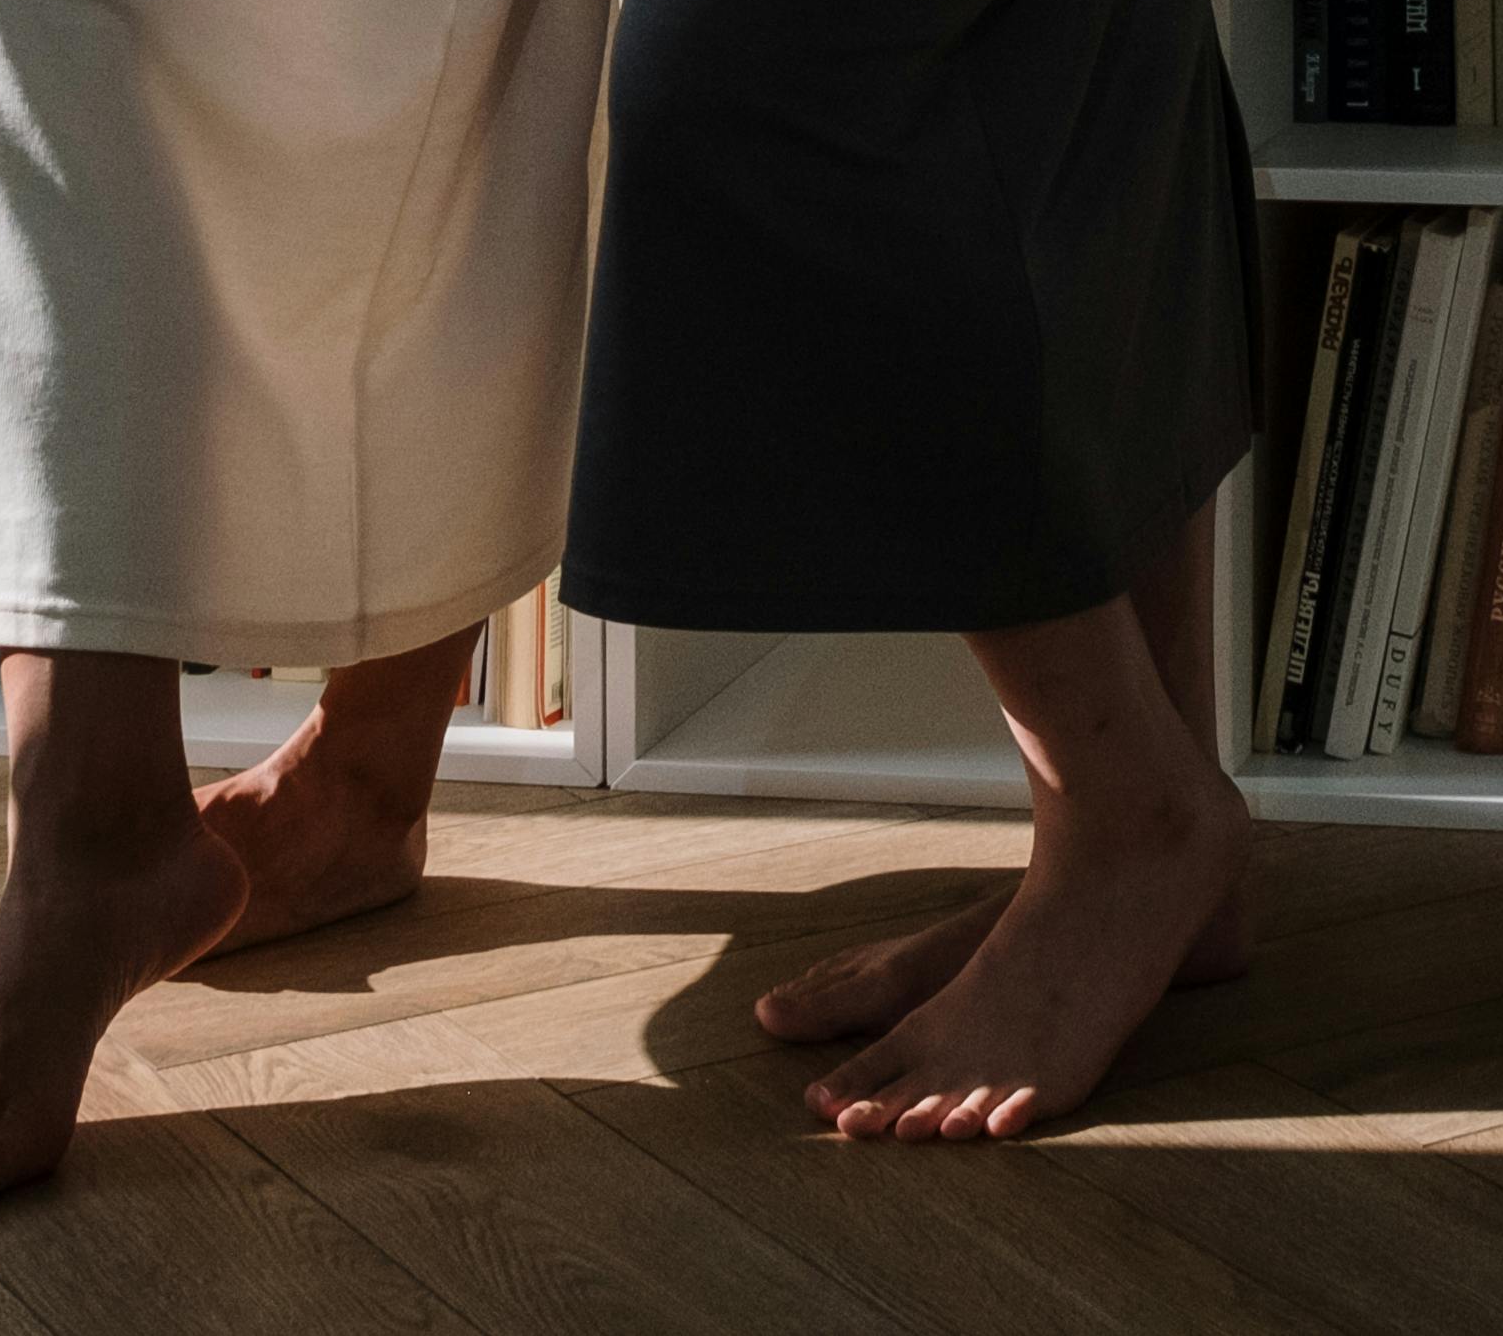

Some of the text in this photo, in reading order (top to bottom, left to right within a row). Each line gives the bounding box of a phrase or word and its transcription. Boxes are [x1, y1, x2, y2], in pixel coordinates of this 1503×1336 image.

[1320, 256, 1354, 352] РАФАЭЛЬ
[1285, 569, 1322, 685] ШЕДЕВРЫ
[1377, 646, 1406, 739] DUFY
